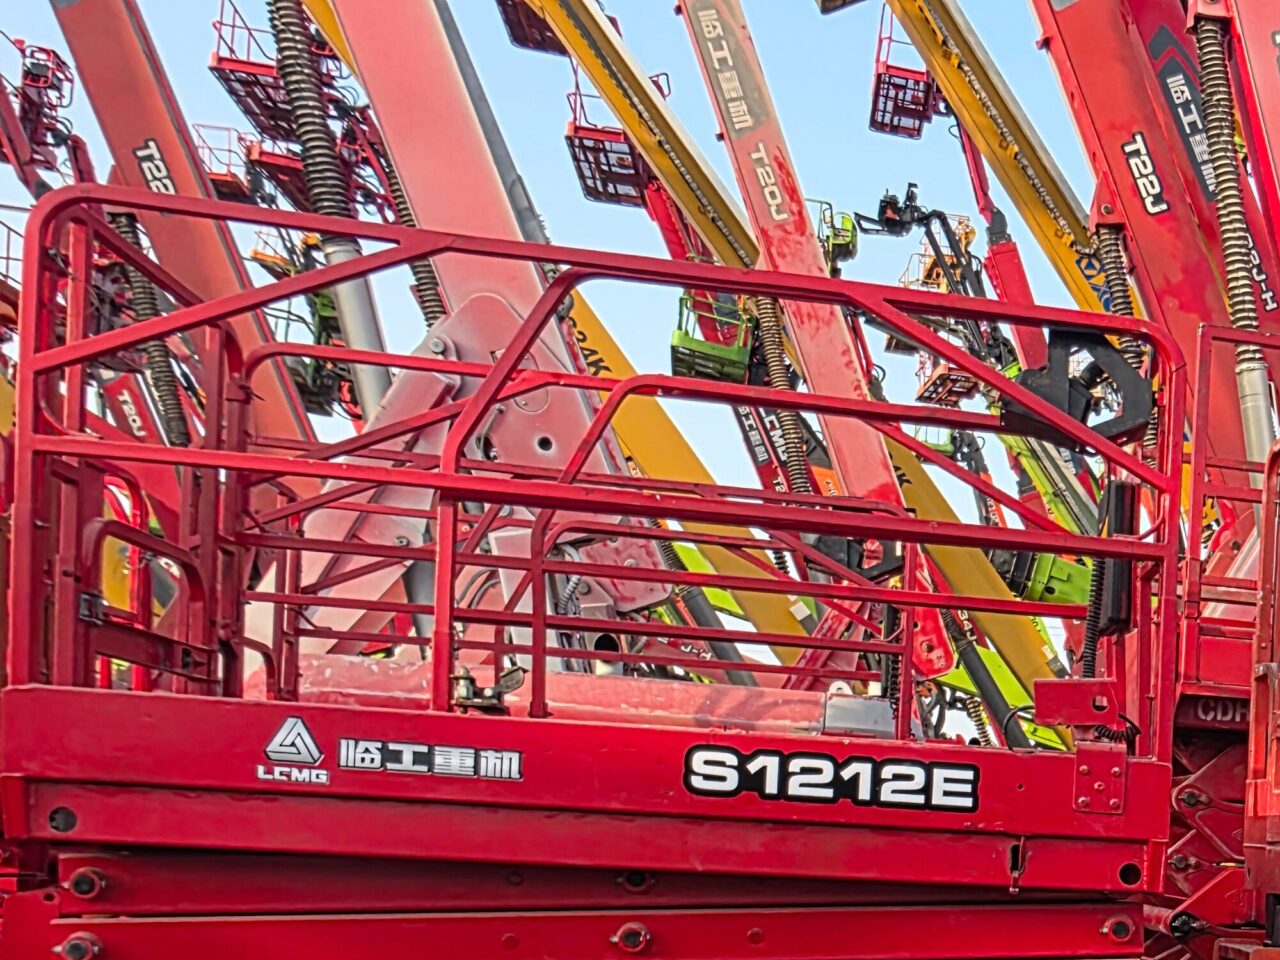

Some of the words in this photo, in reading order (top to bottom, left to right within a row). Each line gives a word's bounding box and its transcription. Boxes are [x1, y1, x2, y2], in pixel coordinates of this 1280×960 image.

[133, 138, 178, 195] T22
[750, 142, 789, 222] T20J
[1123, 133, 1169, 215] T22J
[117, 389, 148, 437] T20J
[1197, 699, 1250, 722] CDH
[339, 738, 522, 781] 临工重机
[687, 749, 979, 810] S1212E
